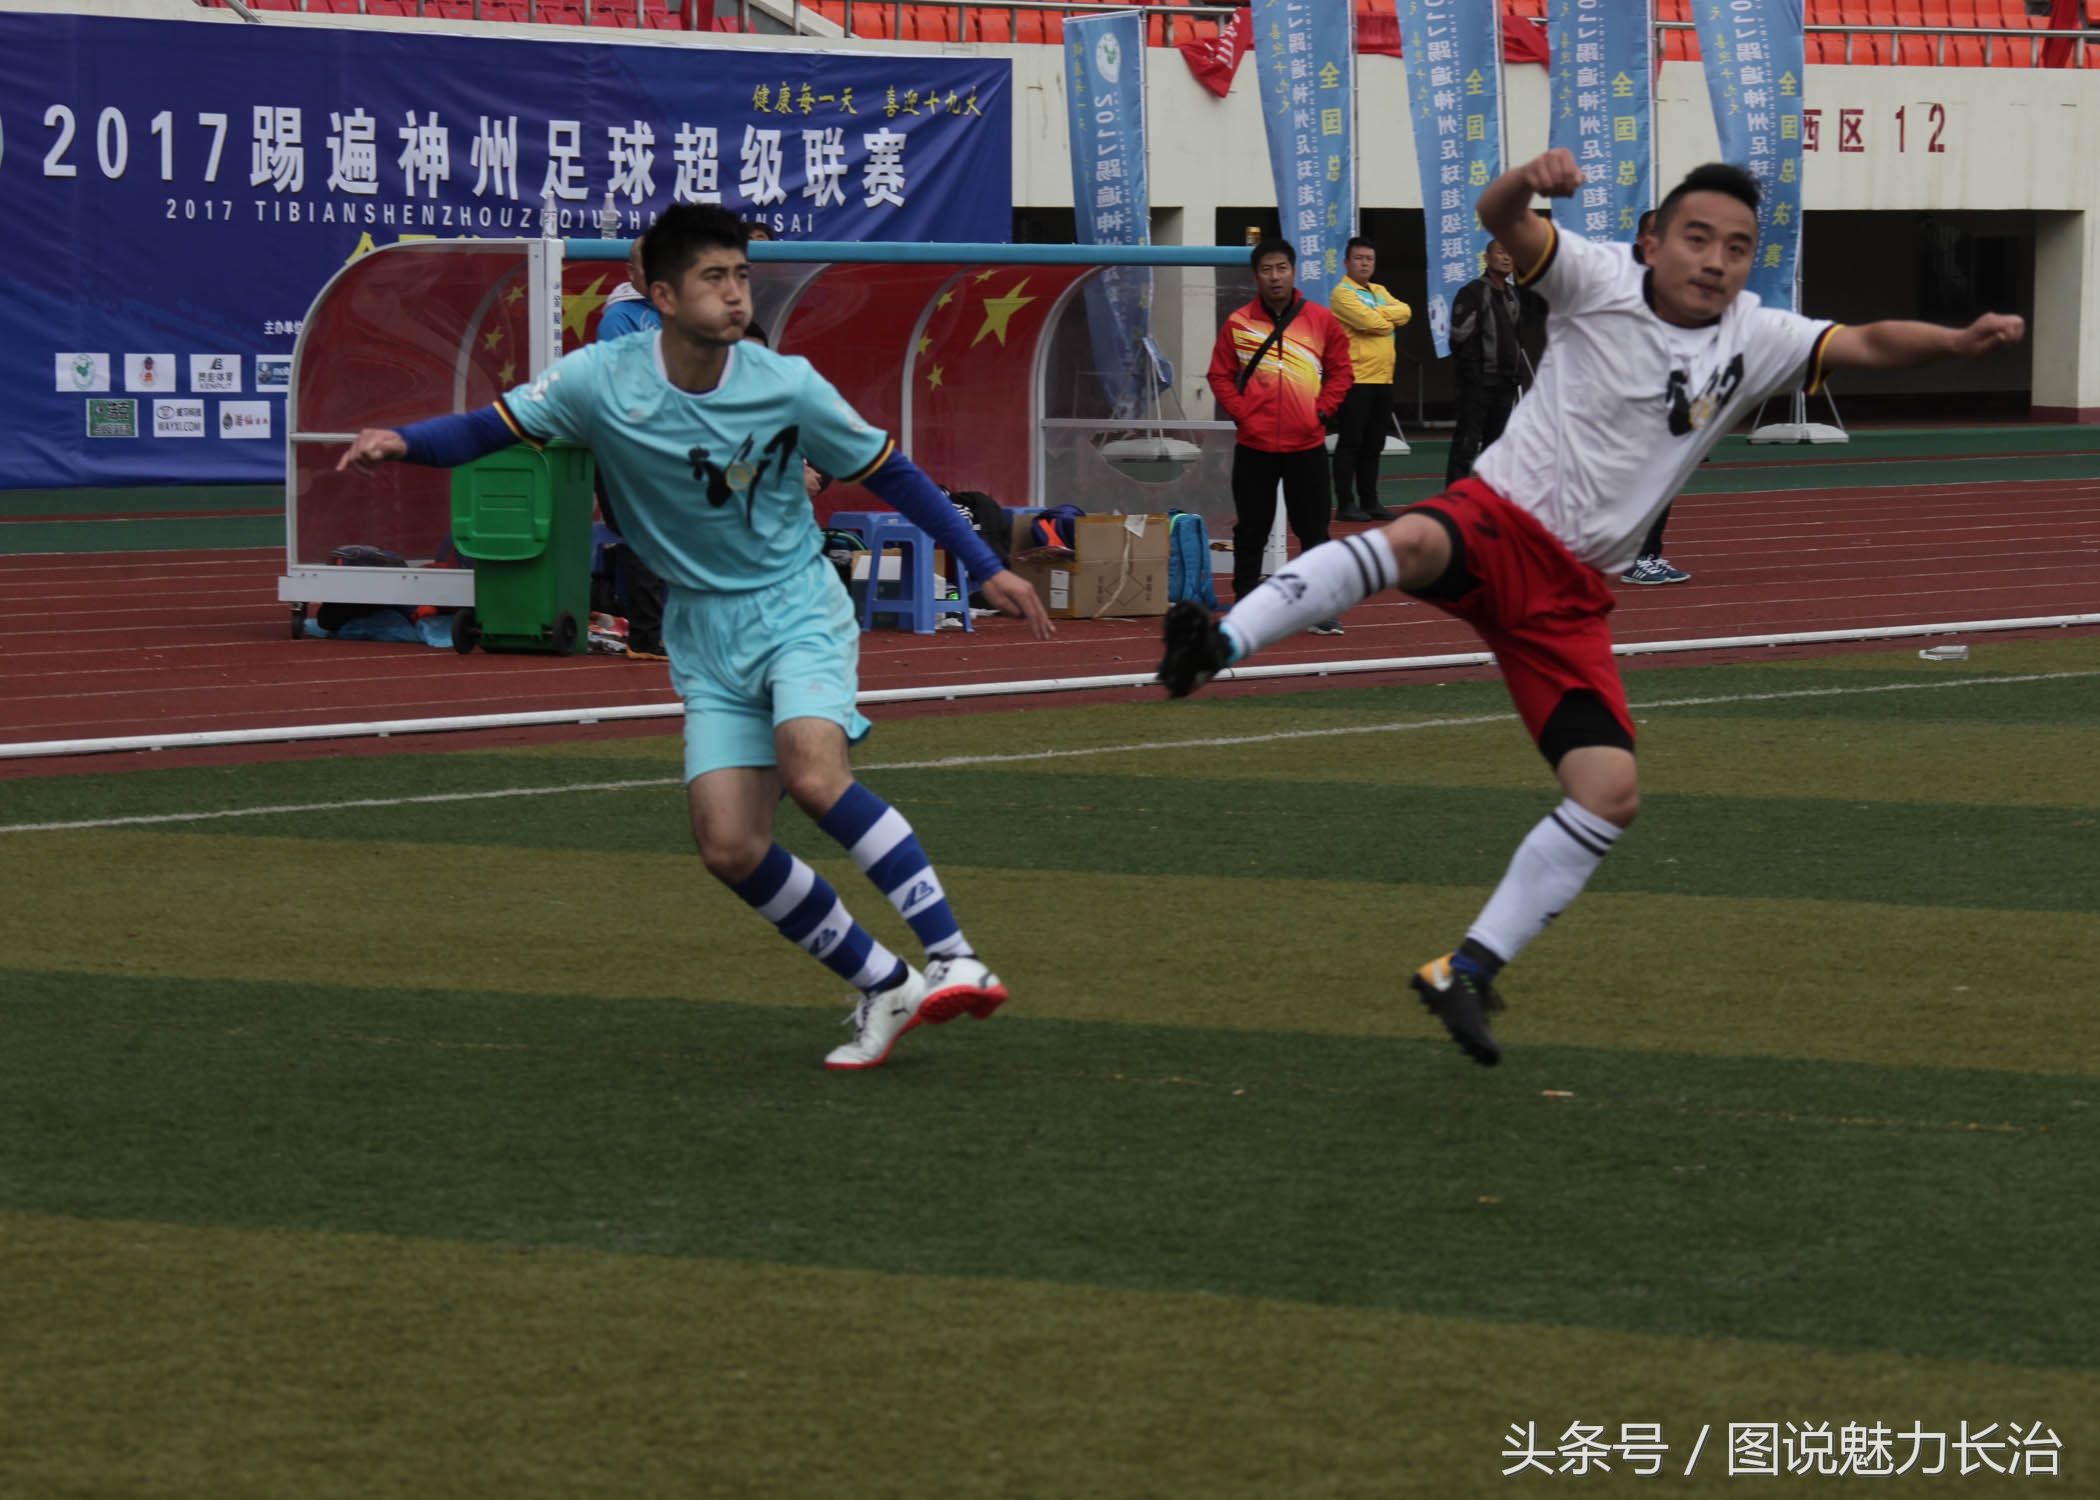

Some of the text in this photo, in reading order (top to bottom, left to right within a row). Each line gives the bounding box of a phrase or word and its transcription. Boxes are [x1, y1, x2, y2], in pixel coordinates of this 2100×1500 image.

[752, 81, 983, 118] 健康每一天 喜迎十九大
[1895, 103, 1946, 153] 12
[166, 198, 233, 221] 2017
